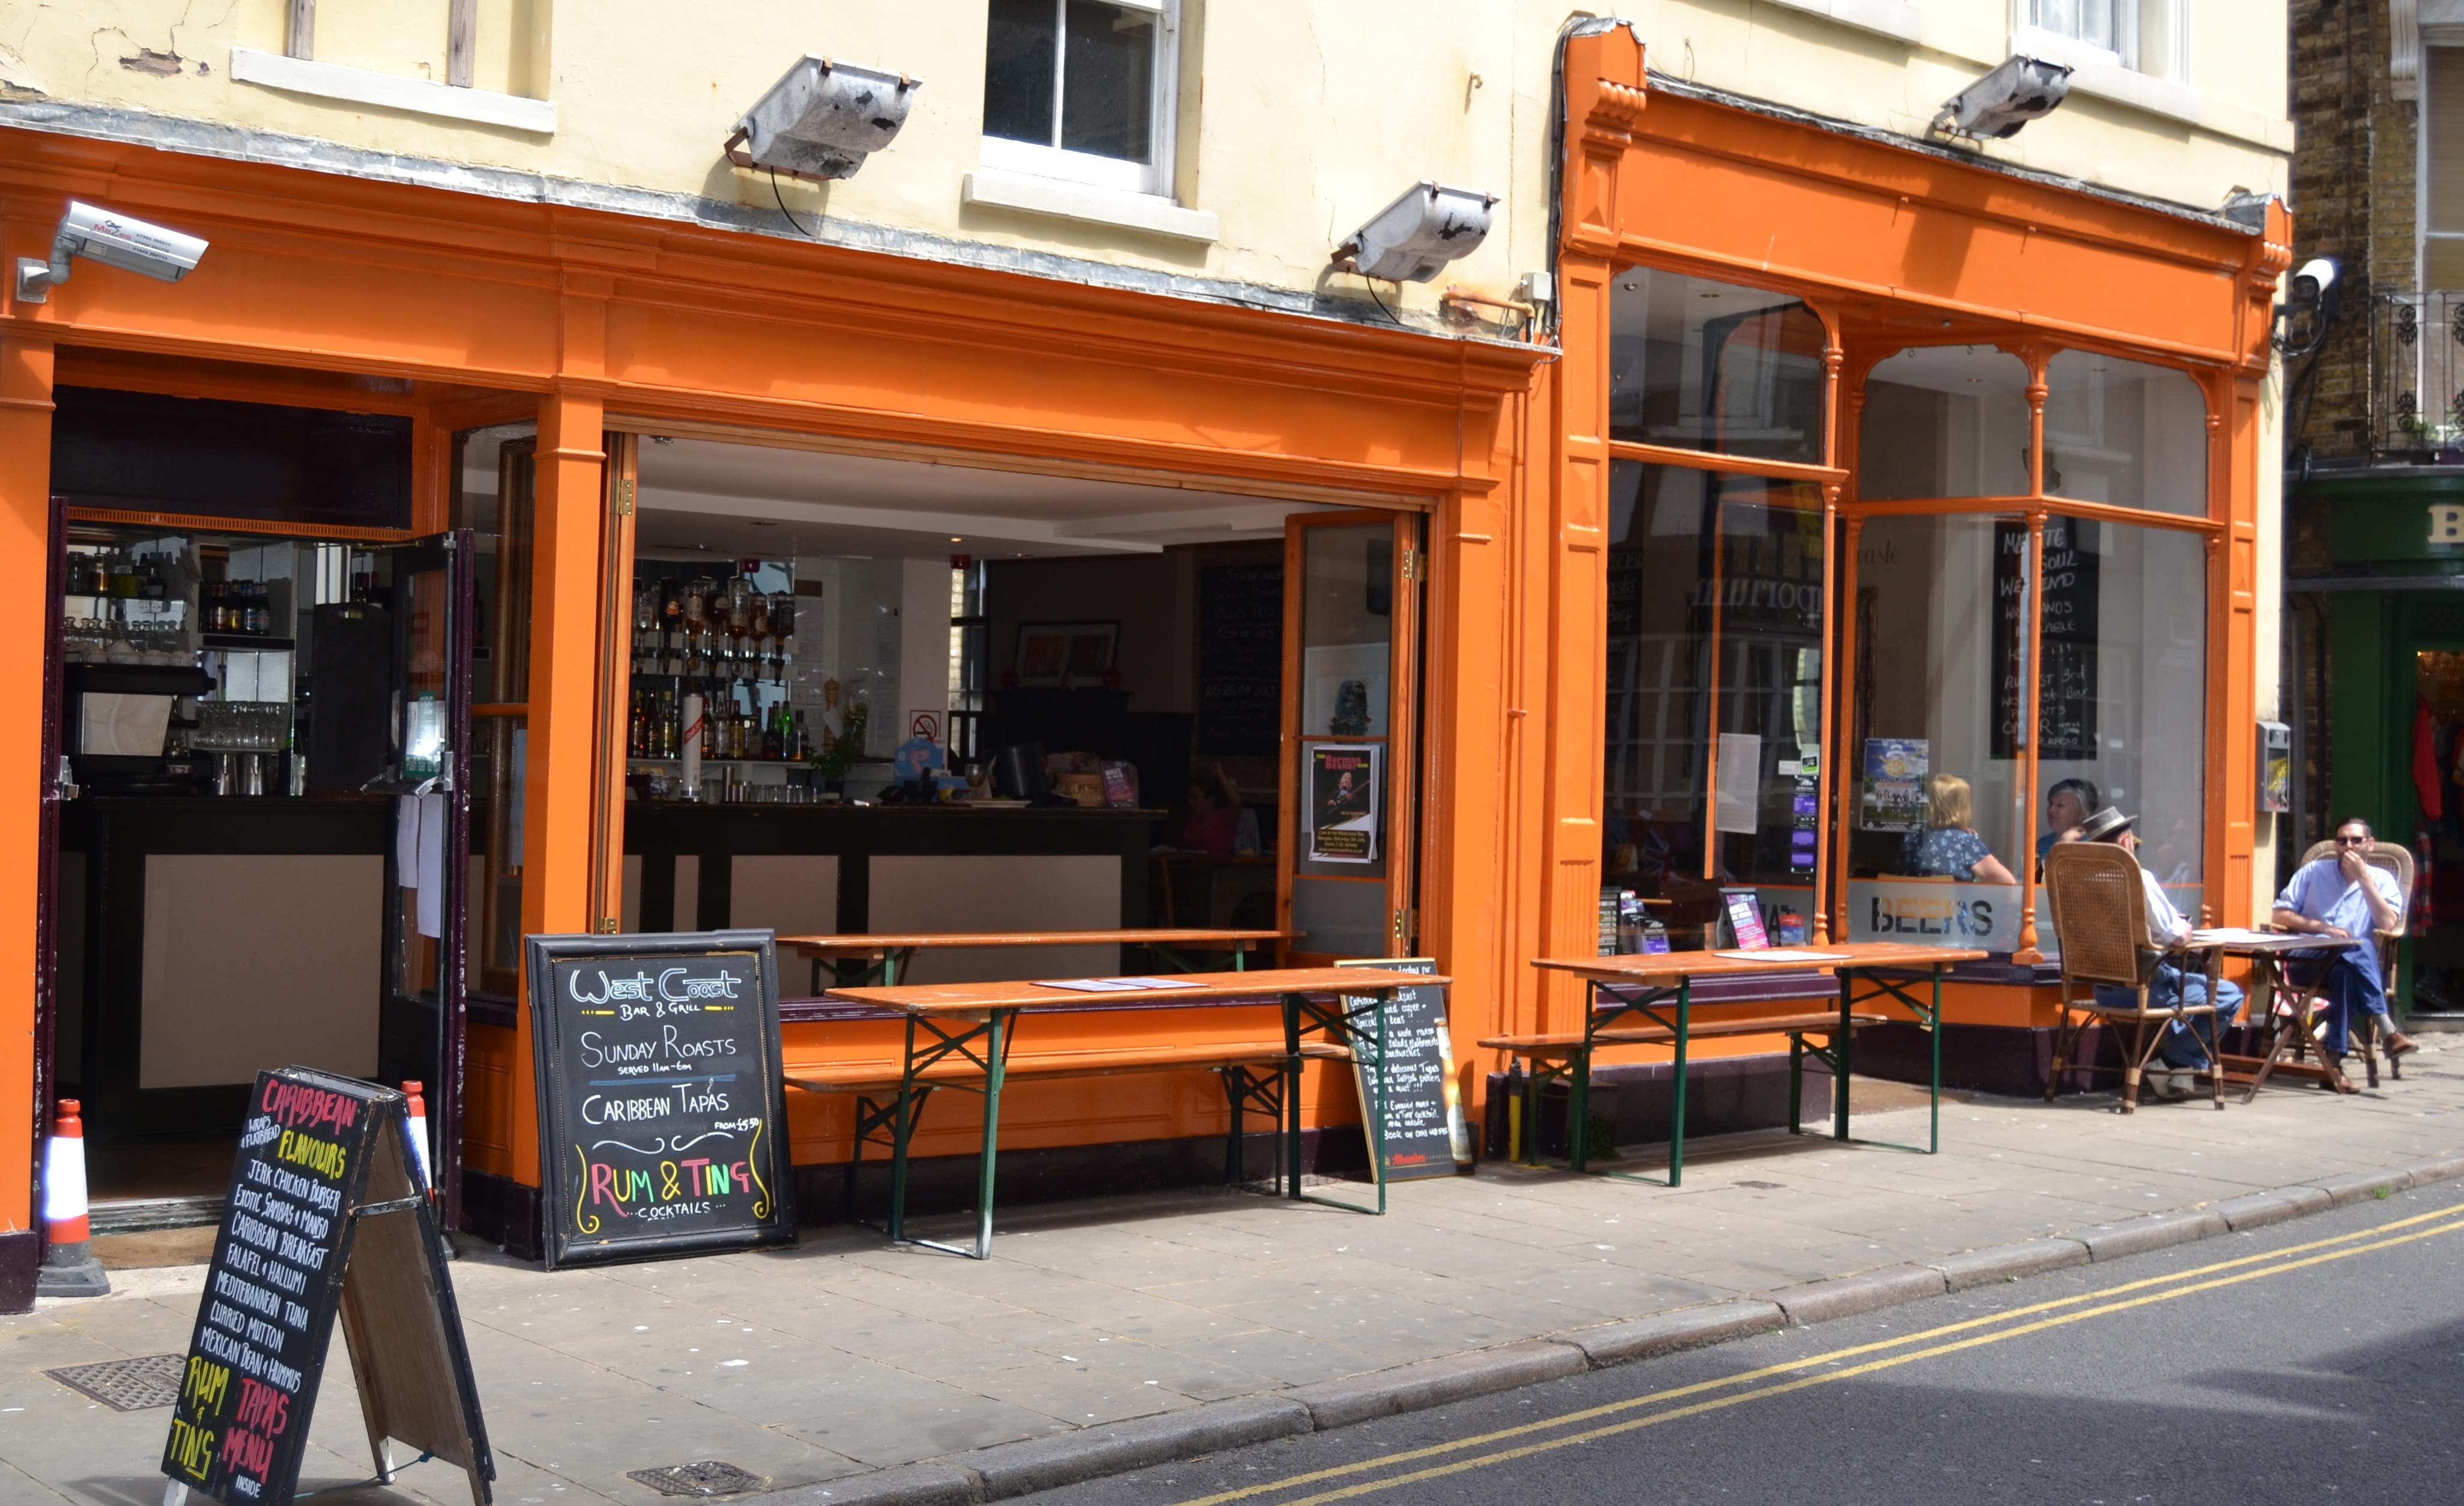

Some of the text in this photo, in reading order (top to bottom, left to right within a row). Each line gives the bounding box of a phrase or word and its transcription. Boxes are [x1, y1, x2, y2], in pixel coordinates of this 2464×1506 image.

[1872, 897, 1993, 936] BEERS
[570, 968, 742, 1004] West Coast
[656, 1002, 666, 1017] &
[581, 1025, 736, 1067] SUNDAY ROASTS
[617, 1065, 649, 1075] SERVED
[249, 1115, 271, 1133] WRAPS
[262, 1079, 357, 1135] CARIBBEAN
[581, 1083, 730, 1125] CARIBBEAN TAPAS
[246, 1124, 281, 1148] FLATBREAD
[714, 1121, 736, 1131] FROM
[278, 1130, 347, 1180] FLAVOURS
[234, 1184, 263, 1212] EXOTIC
[247, 1159, 272, 1186] JERK
[273, 1167, 310, 1199] CHICKEN
[590, 1158, 749, 1218] RUM & TING
[226, 1242, 261, 1277] FALAFEL
[231, 1210, 329, 1270] CARIBBEAN BREAKFAST
[210, 1299, 285, 1353] CURRIED MUTTON
[283, 1301, 309, 1332] TUNA
[199, 1326, 241, 1364] MEXICAN
[240, 1342, 264, 1376] BEAN
[268, 1357, 301, 1393] HUMMUS
[185, 1356, 230, 1416] RUM
[236, 1378, 289, 1439] TAPAS
[221, 1427, 274, 1484] MENU
[235, 1474, 262, 1498] INSIDE
